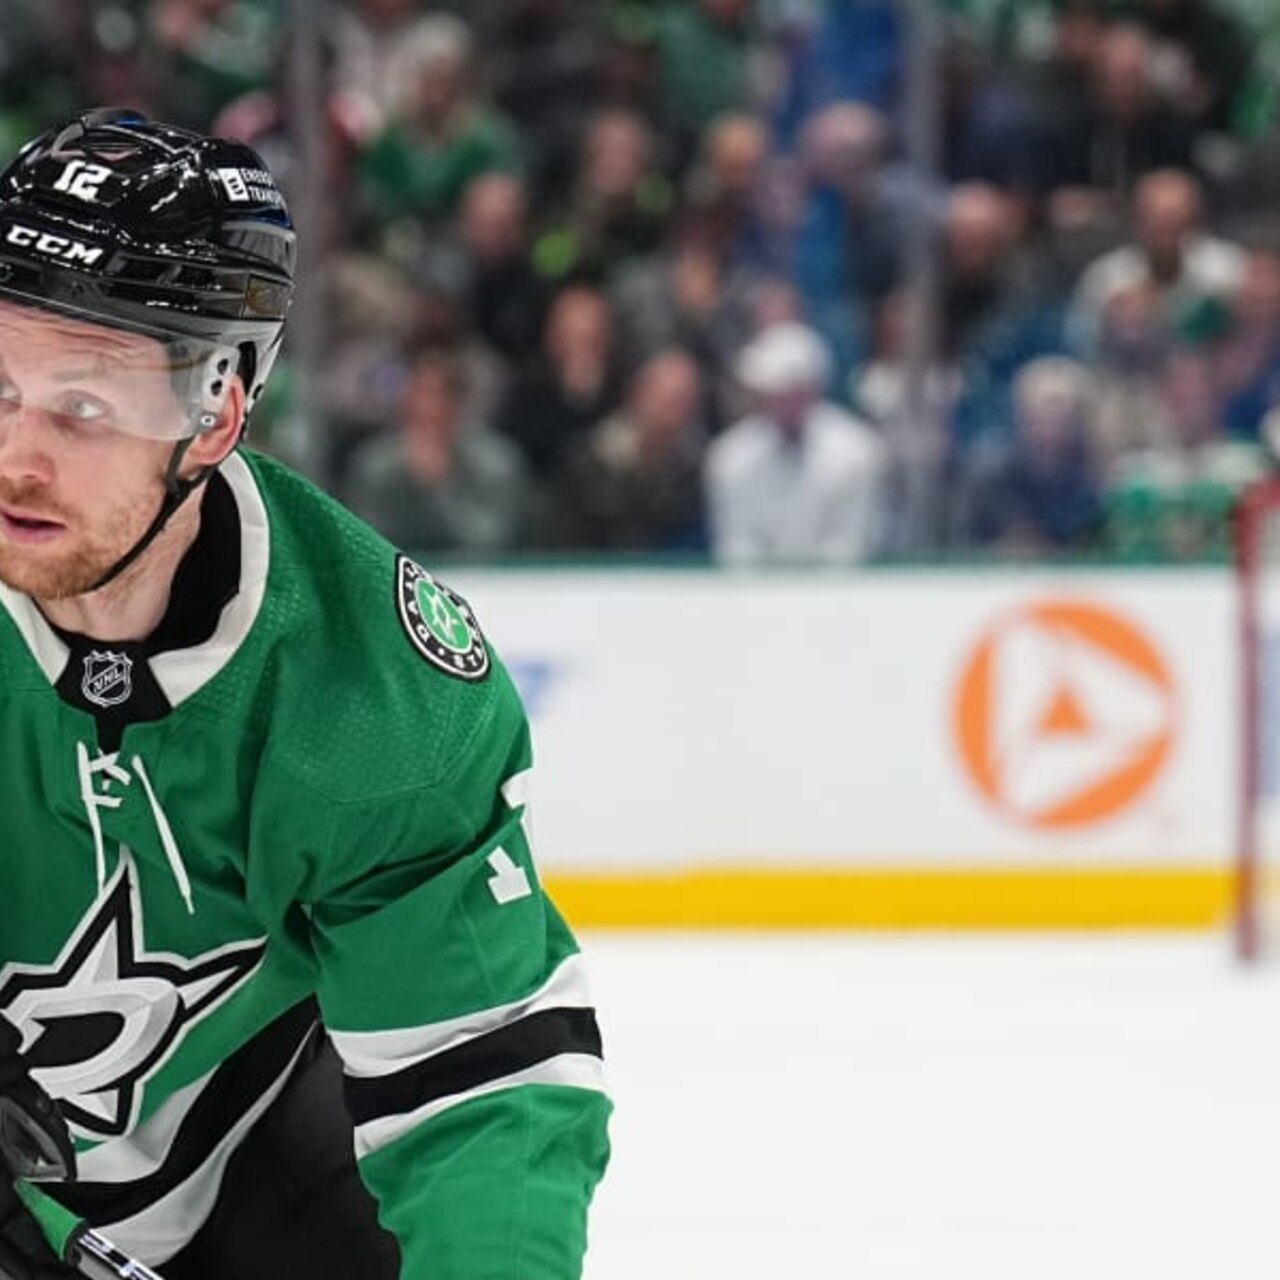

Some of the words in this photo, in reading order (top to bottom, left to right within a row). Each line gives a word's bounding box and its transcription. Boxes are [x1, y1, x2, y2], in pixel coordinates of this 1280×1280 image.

[53, 160, 112, 203] 12
[6, 225, 103, 265] CCM
[92, 666, 122, 694] NHL
